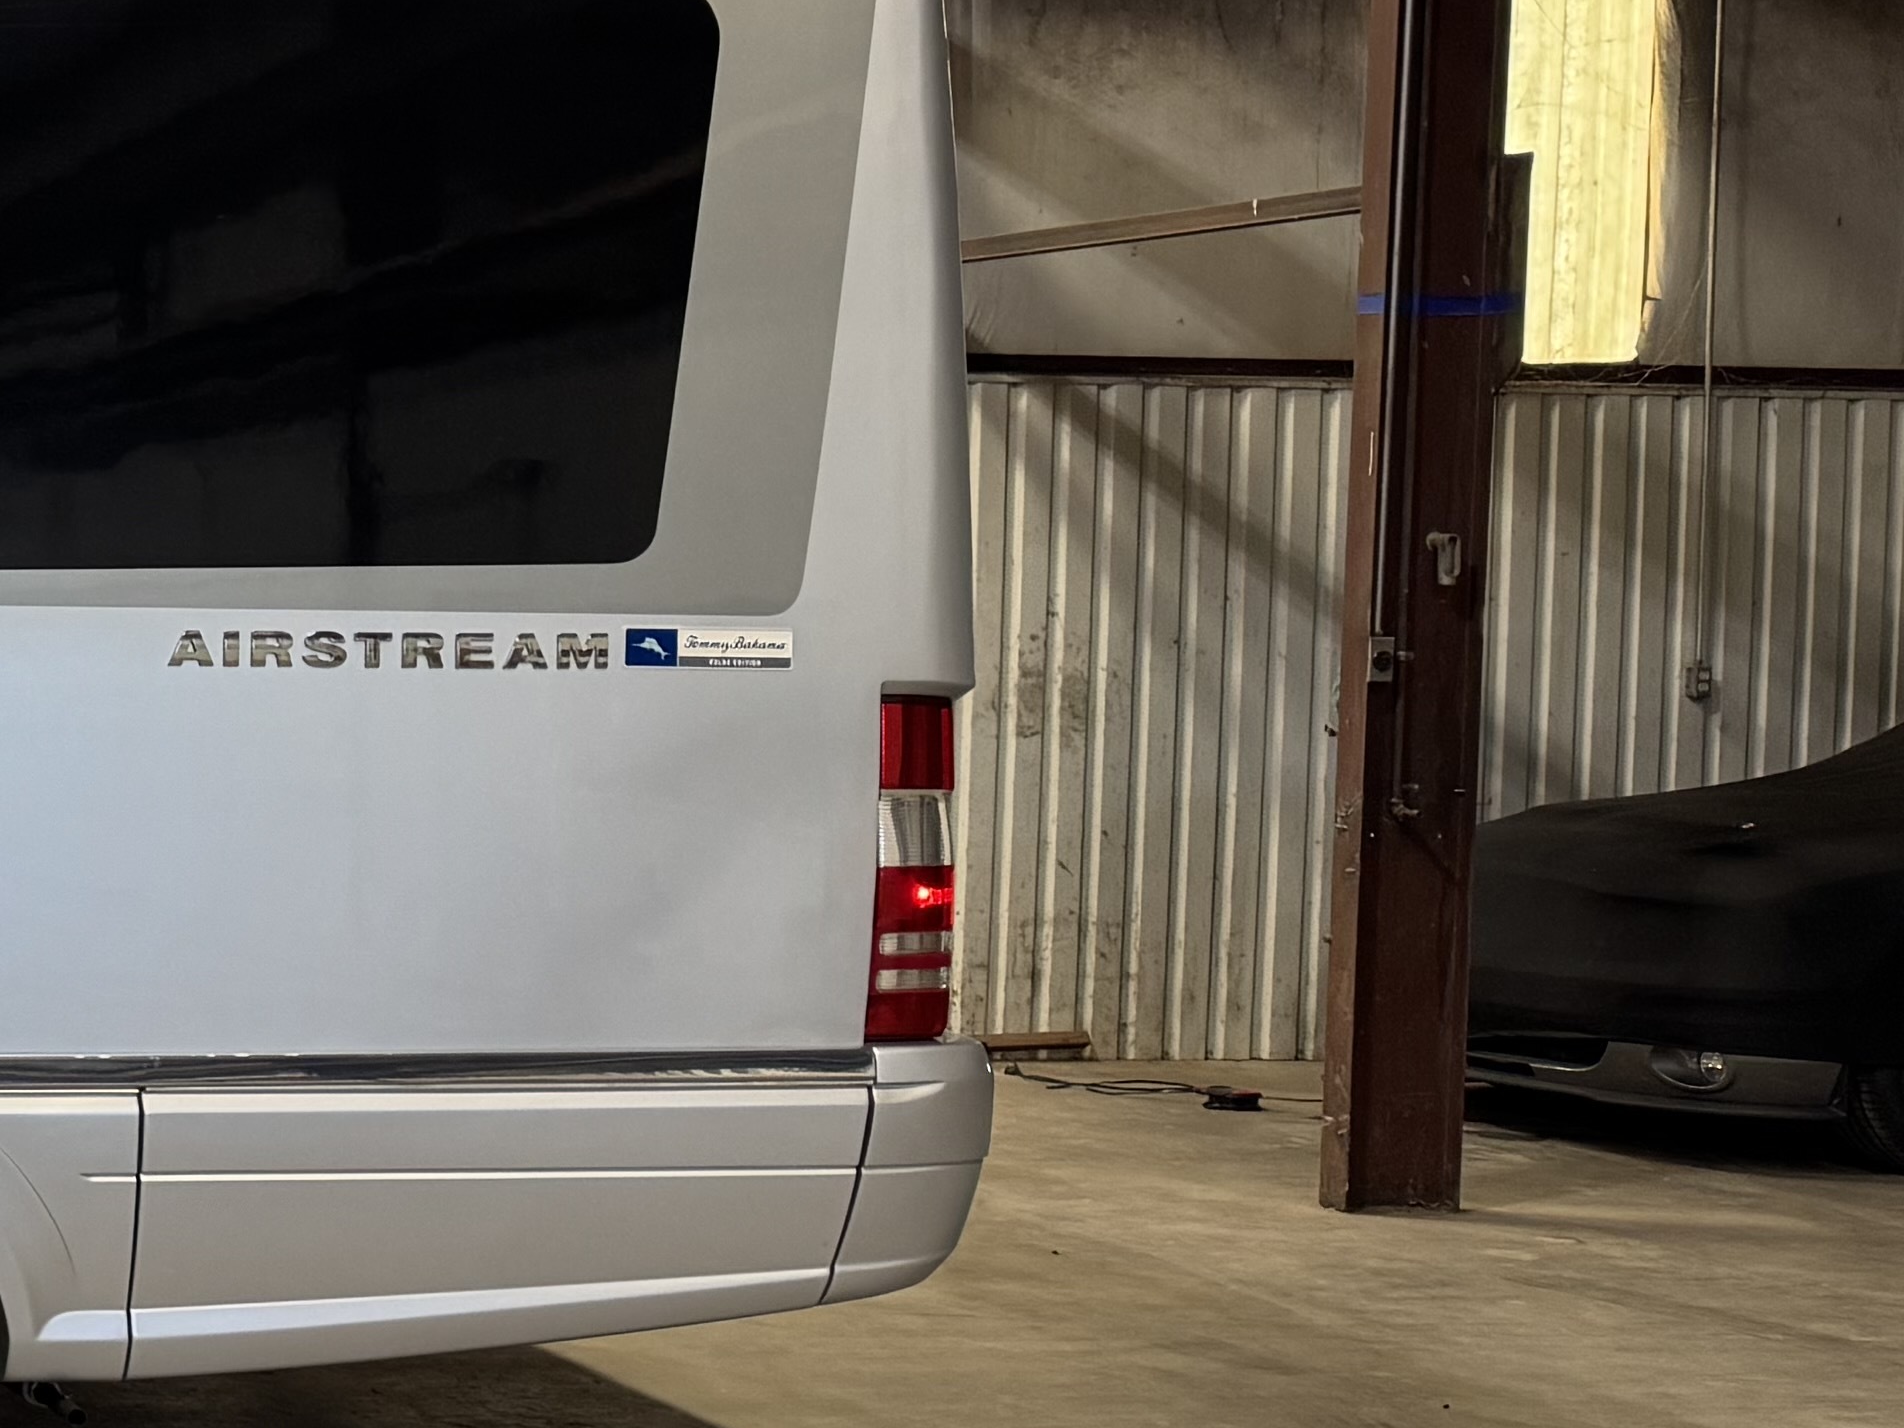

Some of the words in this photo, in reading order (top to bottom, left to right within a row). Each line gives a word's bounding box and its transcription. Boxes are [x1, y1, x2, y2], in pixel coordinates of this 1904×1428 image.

[167, 630, 609, 670] AIRSTREAM
[684, 634, 730, 653] Tommy
[730, 635, 787, 650] Bahama
